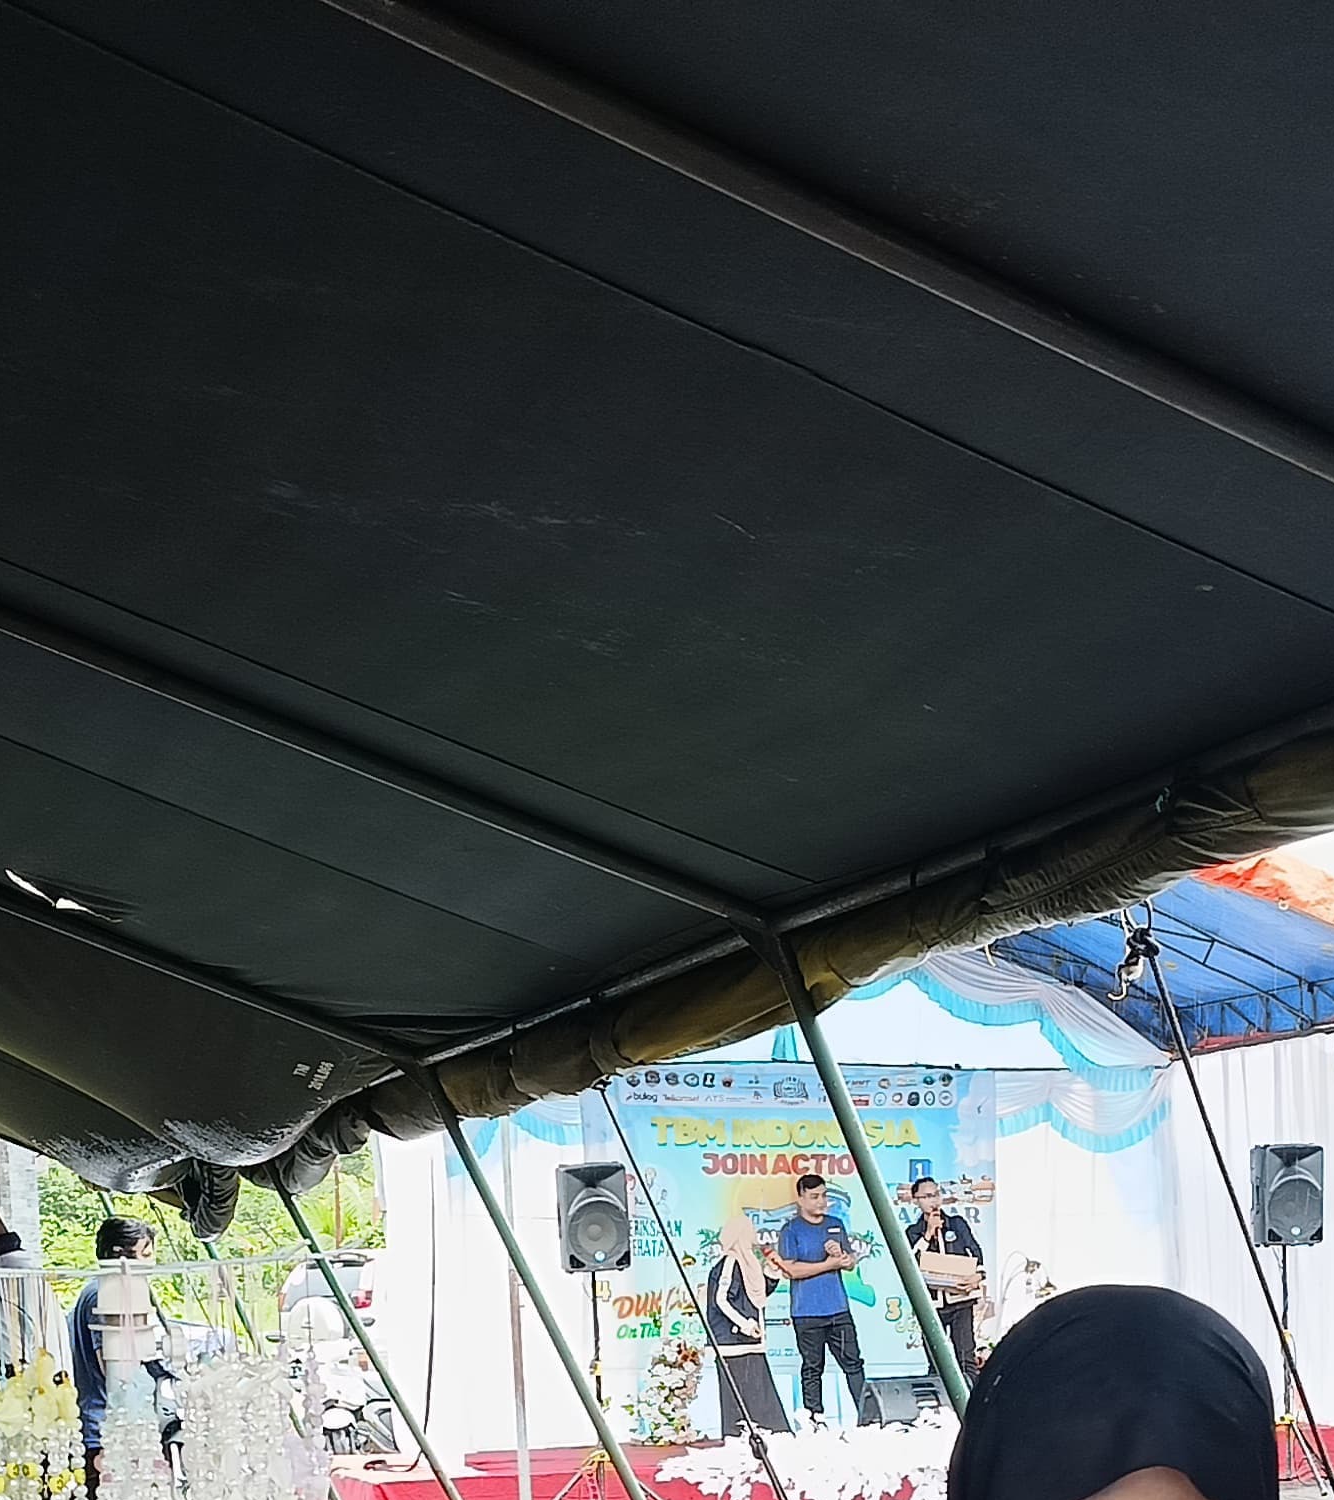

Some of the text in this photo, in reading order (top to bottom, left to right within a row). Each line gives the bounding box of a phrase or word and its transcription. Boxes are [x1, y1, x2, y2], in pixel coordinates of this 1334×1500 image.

[651, 1116, 921, 1150] TBM INDONSIA
[702, 1152, 857, 1176] JOIN ACTIO
[885, 1297, 902, 1321] 3
